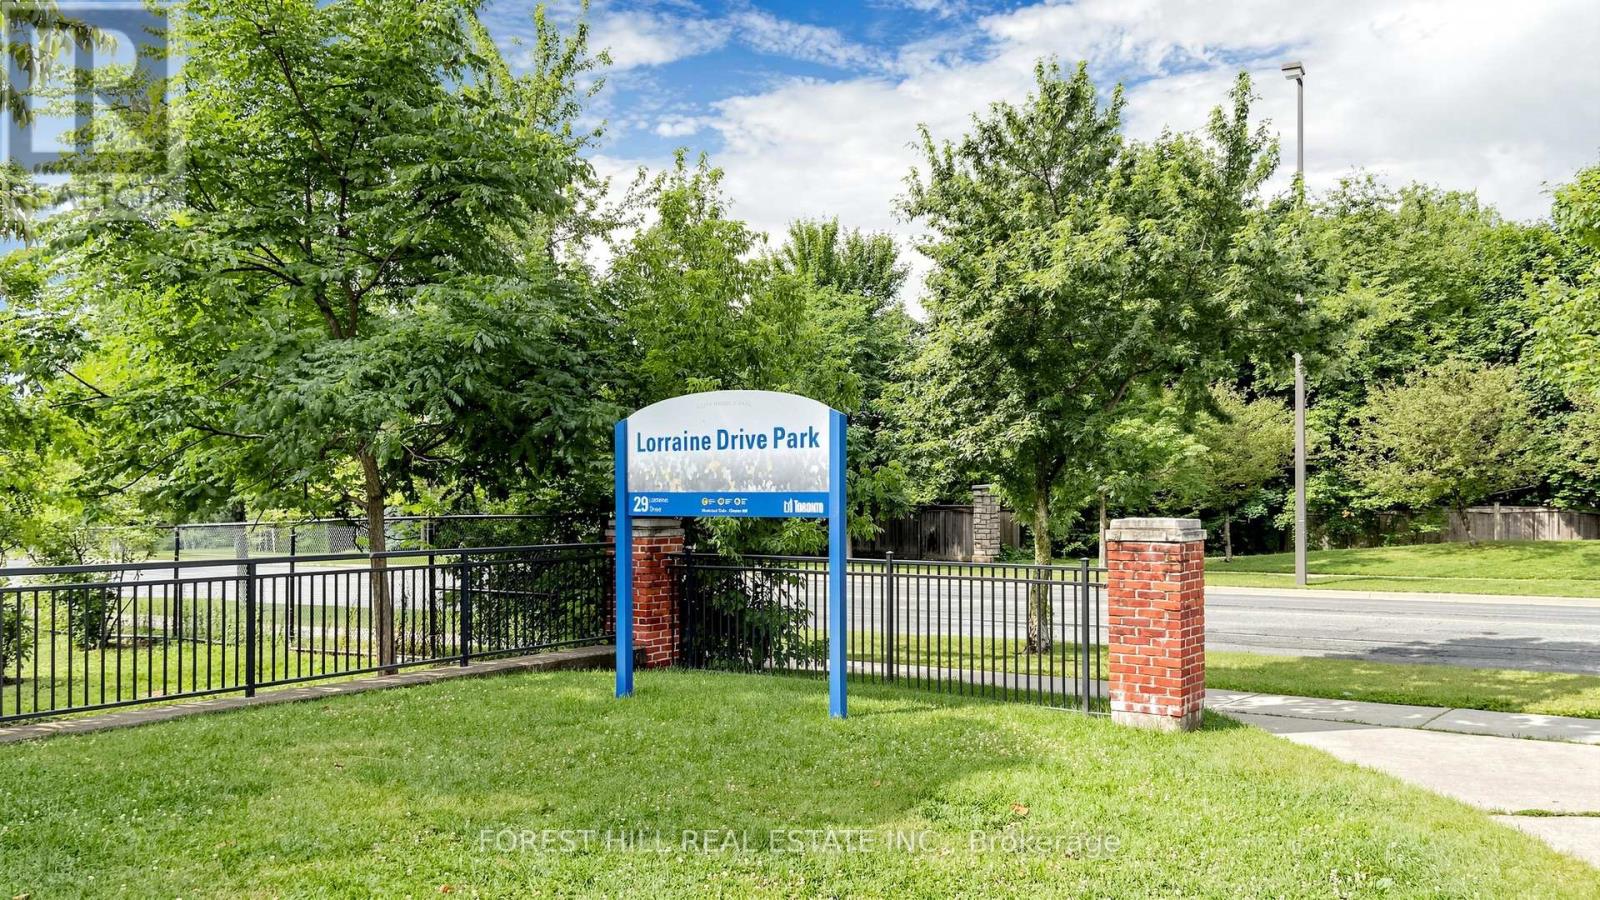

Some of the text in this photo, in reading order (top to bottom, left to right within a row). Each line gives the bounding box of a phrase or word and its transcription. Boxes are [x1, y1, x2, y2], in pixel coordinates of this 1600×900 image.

[637, 426, 820, 453] Lorraine Drive Park
[633, 496, 649, 512] 29
